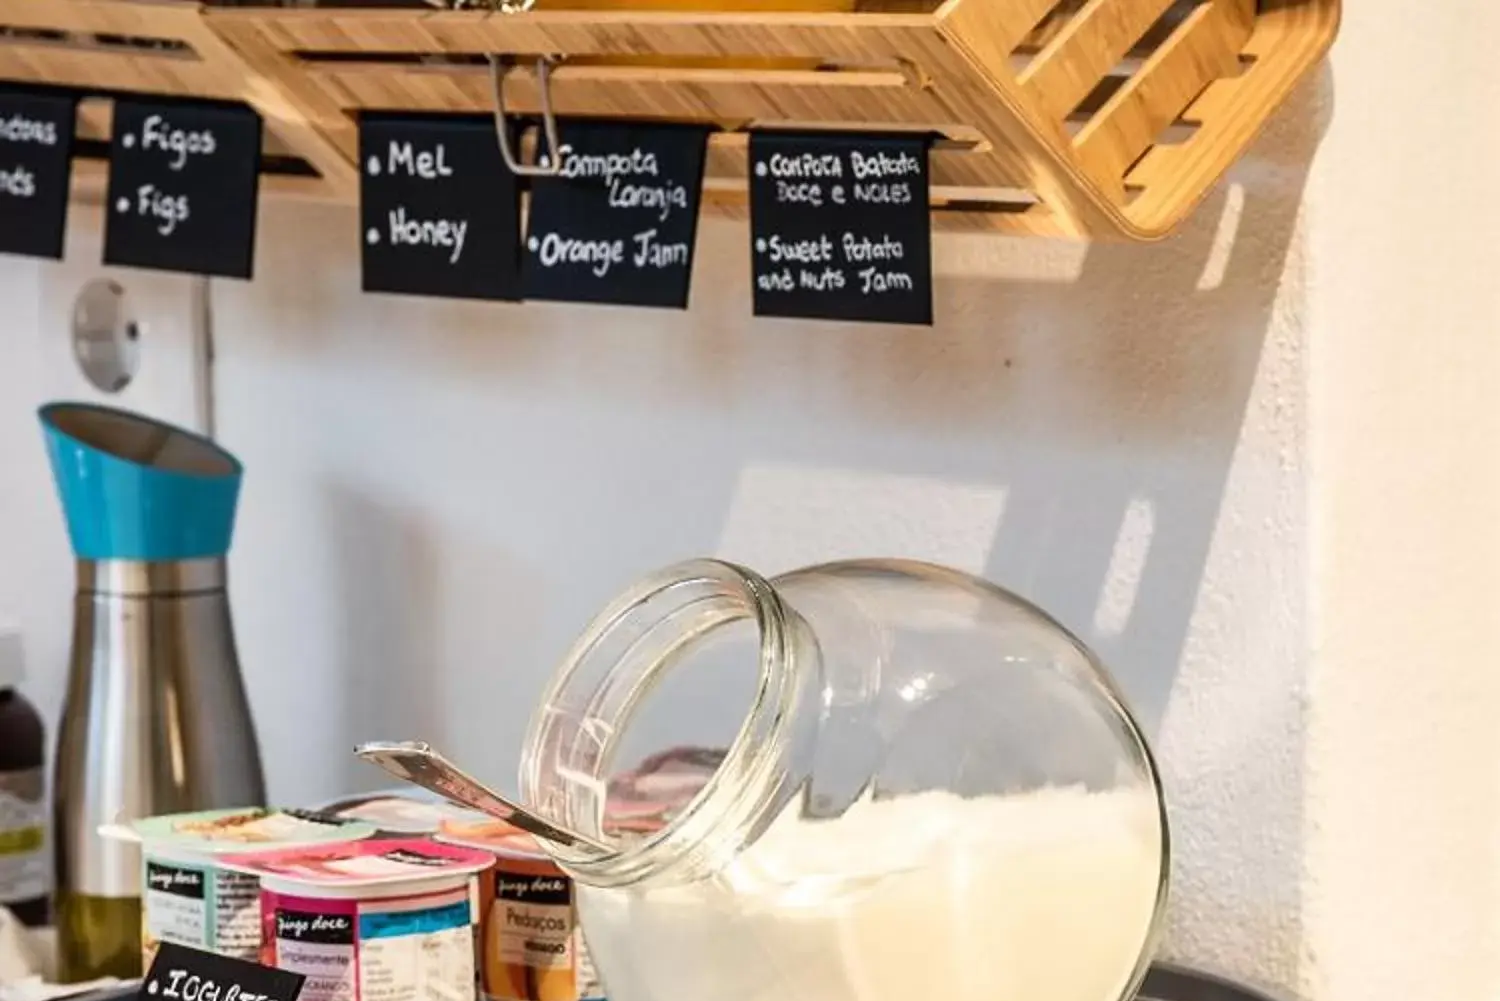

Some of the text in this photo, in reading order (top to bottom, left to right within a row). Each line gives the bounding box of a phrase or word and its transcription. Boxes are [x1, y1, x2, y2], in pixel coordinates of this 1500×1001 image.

[142, 115, 216, 170] Figos
[851, 151, 920, 179] Batata
[137, 184, 189, 235] Figs
[389, 207, 467, 264] Honey
[540, 233, 623, 276] Orange
[769, 232, 903, 262] Sweet Potato
[758, 269, 794, 291] and
